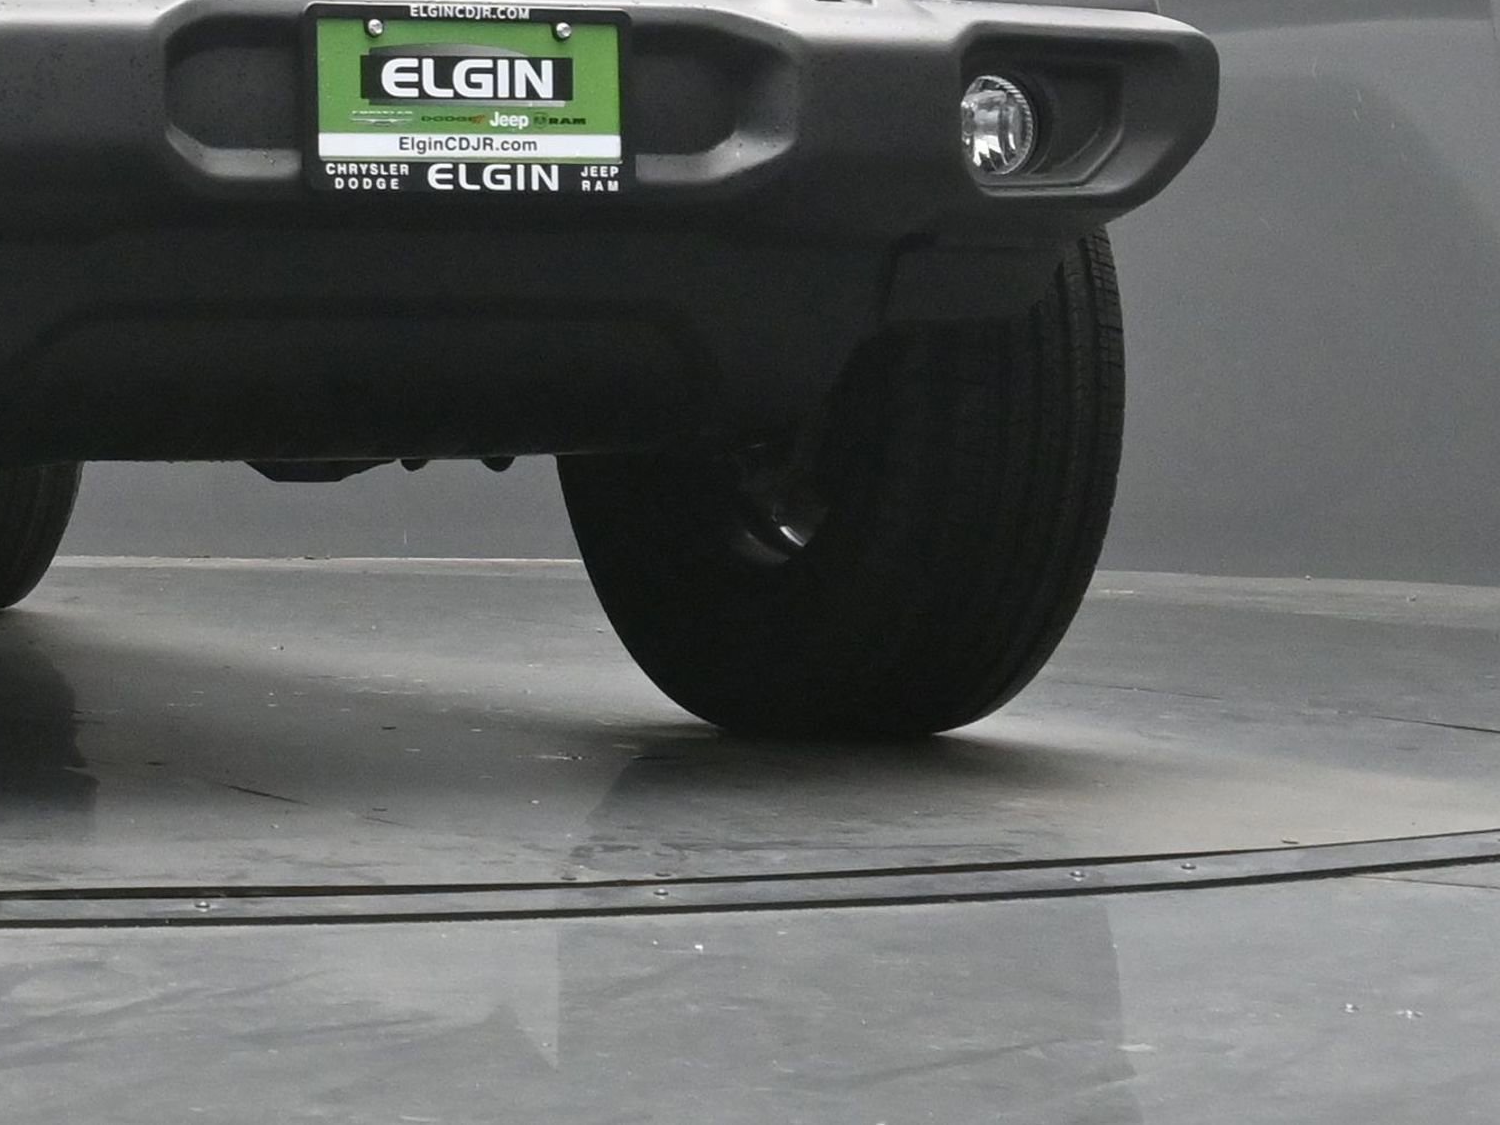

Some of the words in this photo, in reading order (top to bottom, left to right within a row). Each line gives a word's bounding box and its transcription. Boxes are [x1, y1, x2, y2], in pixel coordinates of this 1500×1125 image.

[410, 4, 530, 20] ELGINCDJR.COM
[381, 57, 554, 98] ELGIN
[489, 111, 529, 130] Jeep
[548, 117, 587, 125] RAM
[399, 136, 538, 155] ElginCDJR.com
[325, 162, 409, 176] CHRYSLER
[581, 166, 619, 178] JEEP
[334, 177, 400, 190] DODGE
[427, 162, 559, 192] ELGIN
[581, 180, 619, 192] RAM
